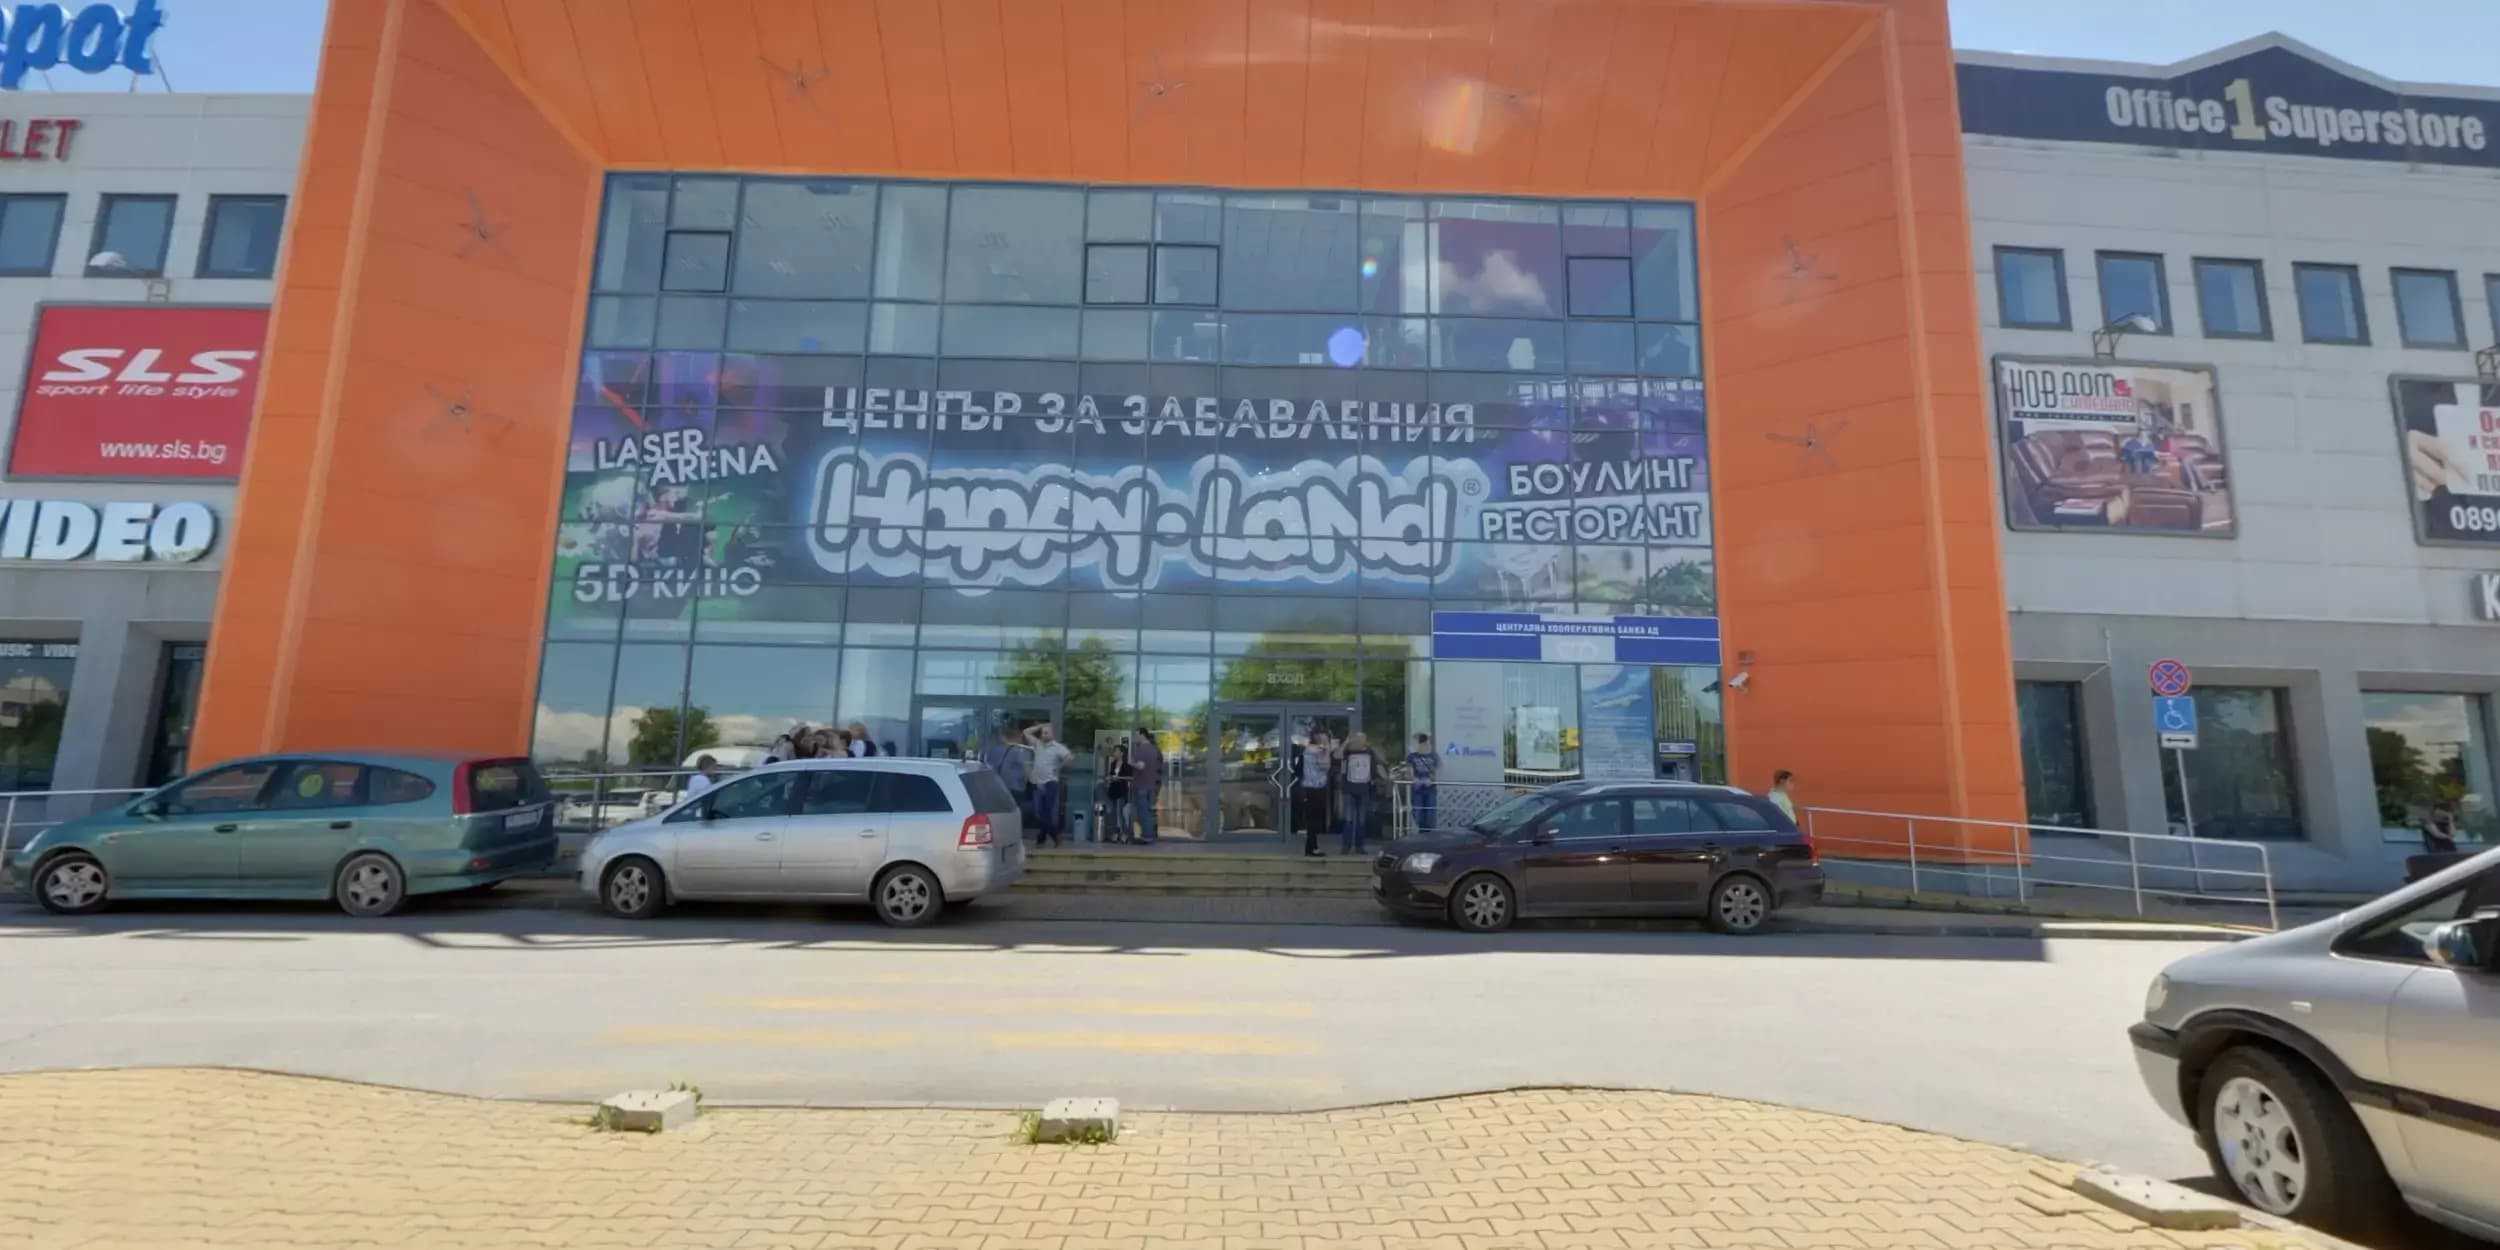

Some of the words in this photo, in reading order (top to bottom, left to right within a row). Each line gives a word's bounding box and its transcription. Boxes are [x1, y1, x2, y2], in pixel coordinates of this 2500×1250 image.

[0, 0, 163, 90] pot
[2105, 86, 2225, 133] Office
[2224, 77, 2266, 141] 1
[2265, 96, 2486, 150] Superstore
[42, 348, 256, 383] SLS
[36, 383, 110, 396] sport
[117, 383, 164, 396] life
[172, 384, 239, 399] style
[822, 386, 1023, 434] ЦЕНТЪР
[1035, 392, 1107, 434] ЗА
[1121, 393, 1475, 443] ЗАБАВЛЕНИЯ
[100, 439, 227, 464] www.sls.bg
[597, 428, 704, 471] LASER
[650, 444, 779, 486] ARENA
[1509, 457, 1694, 496] БОУЛИНГ
[0, 499, 216, 562] IDEO
[1482, 504, 1702, 541] РЕСТОРАНТ
[575, 564, 640, 603] 5D
[652, 566, 762, 599] КИНО
[1495, 622, 1546, 633] ЦЕНТРАЛНА
[1617, 625, 1646, 635] БАНКА
